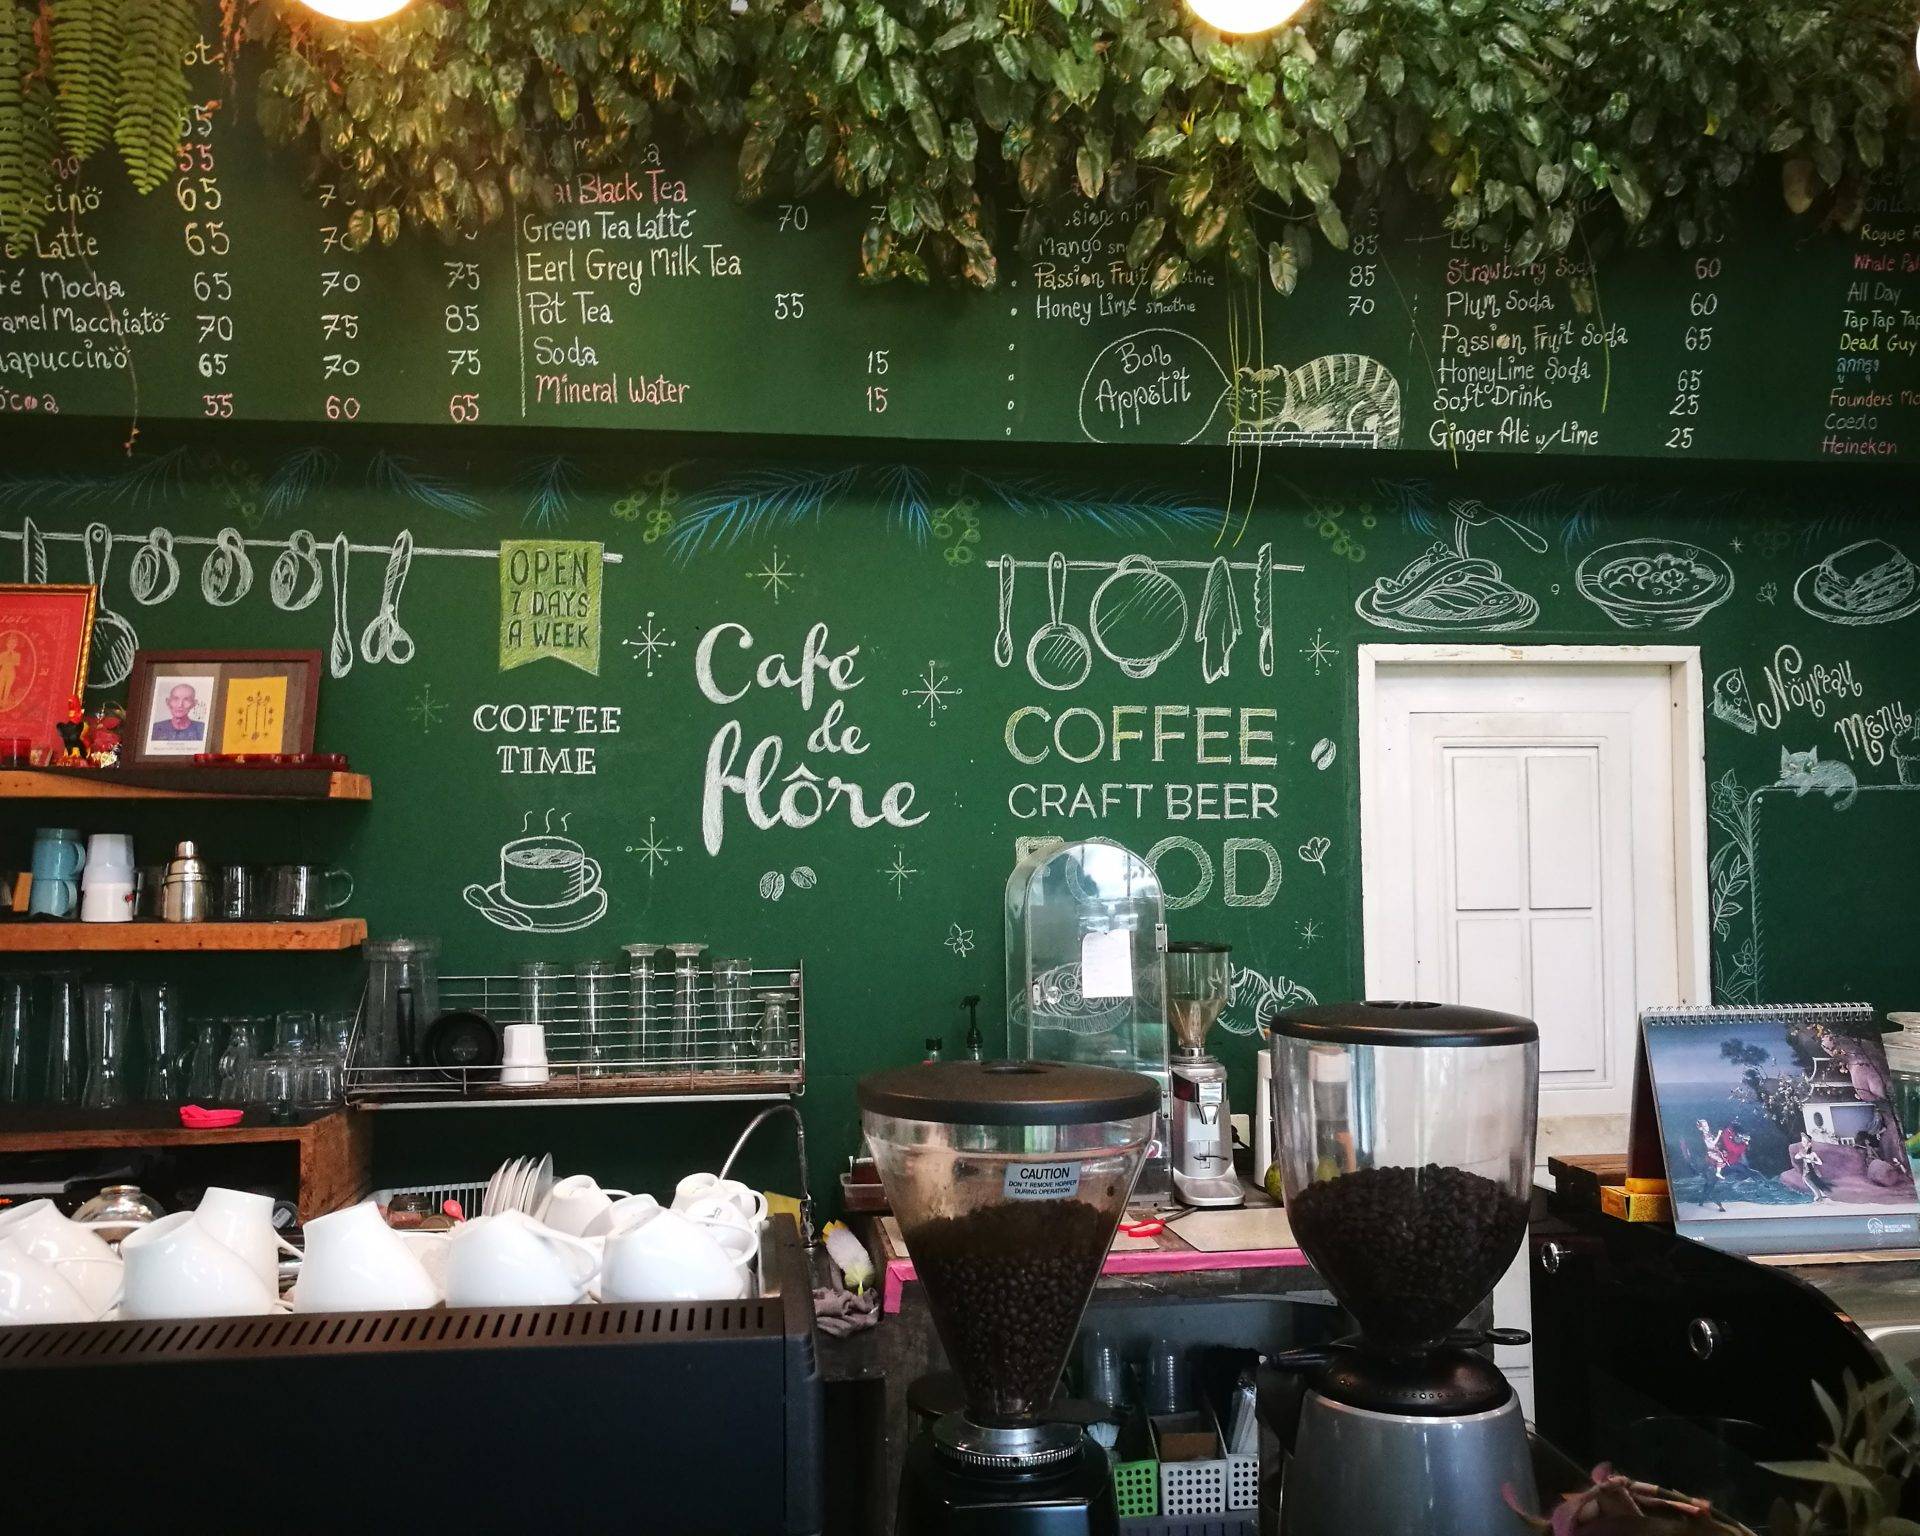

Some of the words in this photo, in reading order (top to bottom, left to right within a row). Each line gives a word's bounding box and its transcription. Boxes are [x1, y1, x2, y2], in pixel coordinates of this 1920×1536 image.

[177, 143, 214, 172] 55
[177, 178, 222, 212] 65
[577, 173, 643, 204] Black
[645, 169, 688, 204] Tea
[523, 213, 591, 242] Green
[594, 211, 632, 240] Tea
[777, 204, 808, 231] 70
[35, 226, 99, 259] Latte
[185, 222, 230, 256] 65
[1353, 234, 1380, 255] 85
[1861, 223, 1906, 247] Rogue
[1039, 236, 1101, 264] Mango
[1854, 253, 1896, 272] Whale
[444, 261, 481, 290] 75
[526, 249, 576, 282] Eerl
[585, 249, 643, 296] Grey
[650, 244, 701, 277] Milk
[702, 244, 742, 276] Tea
[1033, 262, 1105, 290] Passion
[1349, 264, 1377, 287] 85
[1695, 258, 1722, 280] 60
[41, 270, 125, 300] Mocha
[194, 271, 232, 301] 65
[321, 272, 361, 296] 70
[1847, 281, 1870, 302] All
[1873, 281, 1903, 306] Day
[0, 303, 47, 333] amel
[445, 304, 480, 332] 85
[525, 291, 566, 325] Pot
[572, 291, 613, 324] Tea
[774, 292, 804, 319] 55
[1036, 294, 1092, 326] Honey
[1100, 293, 1137, 318] Lime
[1145, 298, 1196, 315] smoothie
[1348, 296, 1375, 316] 70
[1446, 291, 1501, 320] Plum
[1505, 290, 1555, 312] Soda
[1690, 292, 1718, 316] 60
[196, 315, 233, 343] 70
[321, 314, 359, 340] 75
[1842, 309, 1869, 333] Tap
[1871, 309, 1896, 333] Tap
[533, 335, 599, 366] Soda
[1442, 323, 1527, 356] Passion
[1533, 320, 1574, 353] Fruit
[1581, 322, 1629, 348] Soda
[1685, 326, 1712, 351] 65
[1840, 333, 1879, 352] Dead
[1886, 333, 1917, 358] Guy
[199, 353, 229, 377] 65
[322, 354, 360, 380] 70
[448, 349, 481, 376] 75
[868, 350, 889, 374] 15
[1114, 341, 1172, 374] Bon
[1544, 356, 1591, 384] Soda
[536, 372, 618, 405] Mineral
[628, 374, 691, 405] Water
[1677, 369, 1703, 392] 65
[203, 394, 234, 418] 55
[326, 395, 361, 420] 60
[450, 393, 480, 424] 65
[866, 386, 888, 413] 15
[1433, 382, 1485, 412] Soft
[1491, 384, 1553, 410] Drink
[1669, 394, 1701, 416] 25
[1829, 387, 1895, 408] Founders
[1429, 419, 1494, 451] Ginger
[1561, 420, 1599, 447] Lime
[1665, 427, 1695, 449] 25
[1821, 434, 1897, 455] Heineken
[510, 550, 589, 588] OPEN
[511, 591, 522, 617] 7
[532, 591, 590, 618] DAYS
[508, 620, 523, 648] A
[533, 621, 590, 648] WEEK
[695, 622, 866, 711] Café
[473, 703, 622, 734] COFFEE
[807, 699, 871, 755] de
[1004, 705, 1278, 766] COFFEE
[496, 745, 597, 775] TIME
[1008, 783, 1153, 819] CRAFT
[1165, 783, 1279, 820] BEER
[1008, 1180, 1029, 1188] DONT
[1020, 1167, 1070, 1180] CAUTION
[1039, 1186, 1070, 1195] OPERATION
